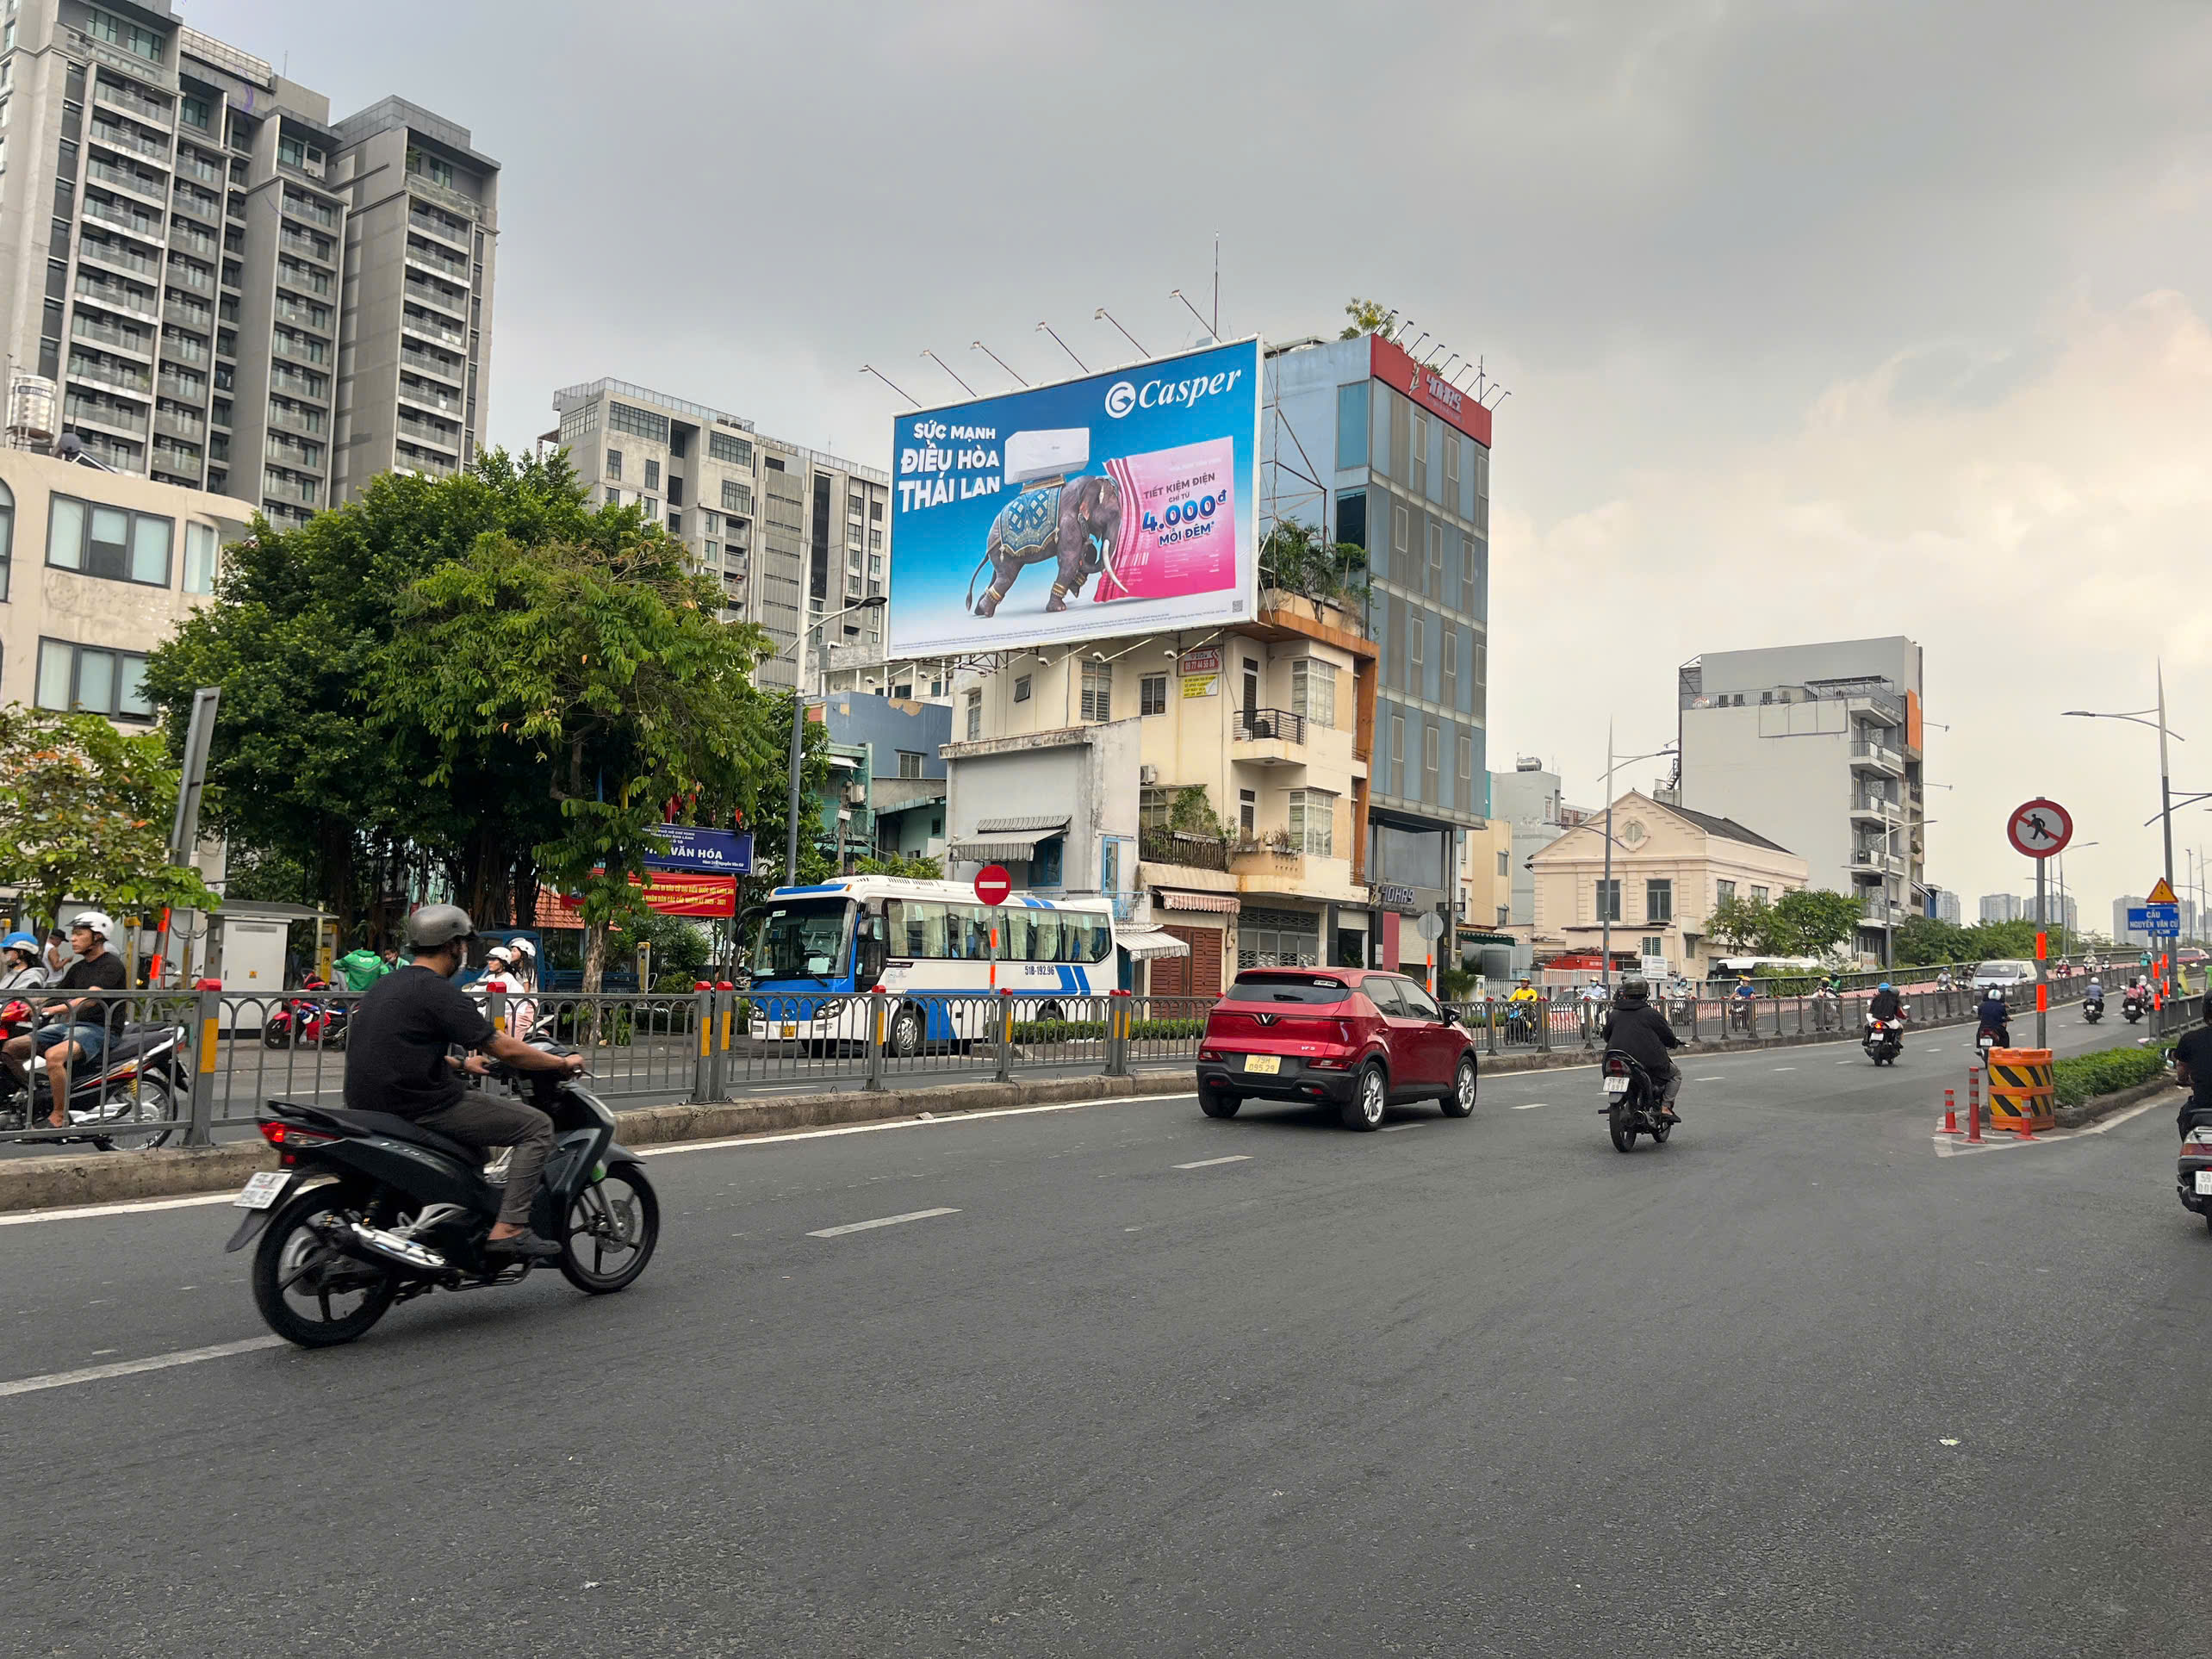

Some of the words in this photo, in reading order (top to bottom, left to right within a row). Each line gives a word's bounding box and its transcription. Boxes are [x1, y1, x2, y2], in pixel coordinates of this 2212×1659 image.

[1139, 370, 1241, 408] Casper
[913, 419, 947, 440] SỨC
[950, 426, 996, 443] MẠNH
[900, 439, 953, 475] ĐIỀU
[957, 444, 1000, 469] HÒA
[898, 471, 955, 513] THÁI
[960, 476, 1000, 500] LAN
[1143, 484, 1164, 500] TIẾT
[1166, 479, 1190, 494] KIỆM
[1192, 472, 1215, 486] ĐIỆN
[1159, 528, 1182, 546] MỖI
[670, 845, 695, 857] VĂN
[698, 848, 723, 860] HÓA
[2129, 919, 2154, 929] NGUYỄN
[2156, 919, 2168, 928] VĂN
[2146, 909, 2160, 918] CẦU
[1024, 966, 1055, 976] 51B-192.96
